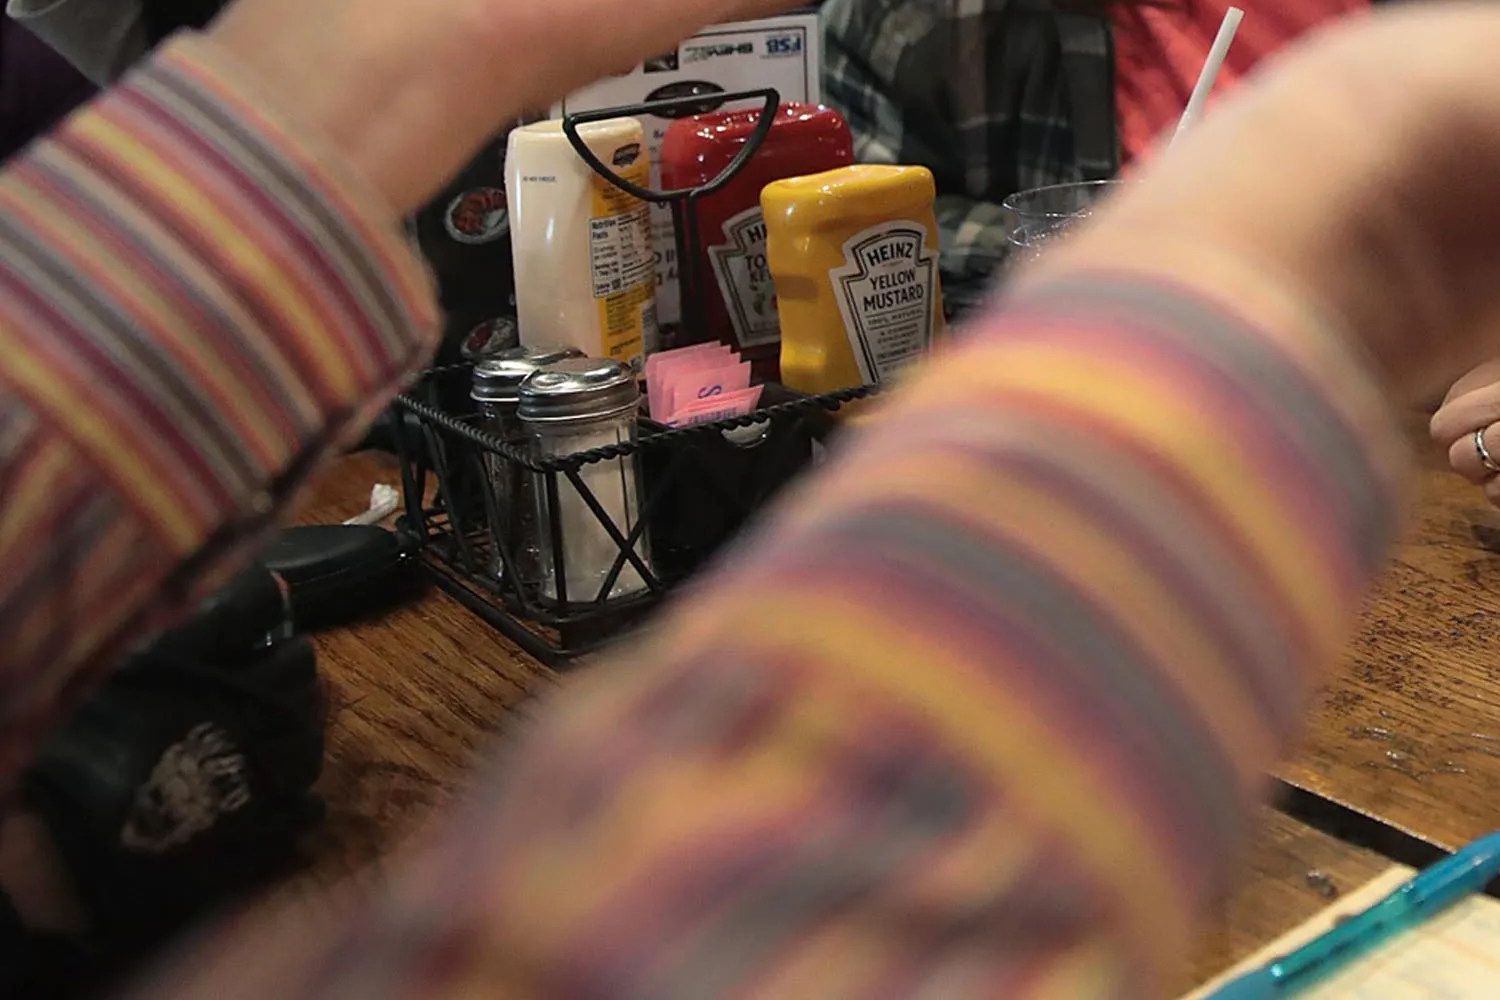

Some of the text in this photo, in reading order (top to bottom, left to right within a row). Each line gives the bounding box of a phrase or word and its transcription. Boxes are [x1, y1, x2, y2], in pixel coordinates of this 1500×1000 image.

[866, 242, 914, 267] HEINZ
[869, 268, 917, 291] YELLOW
[863, 284, 925, 313] MUSTARD
